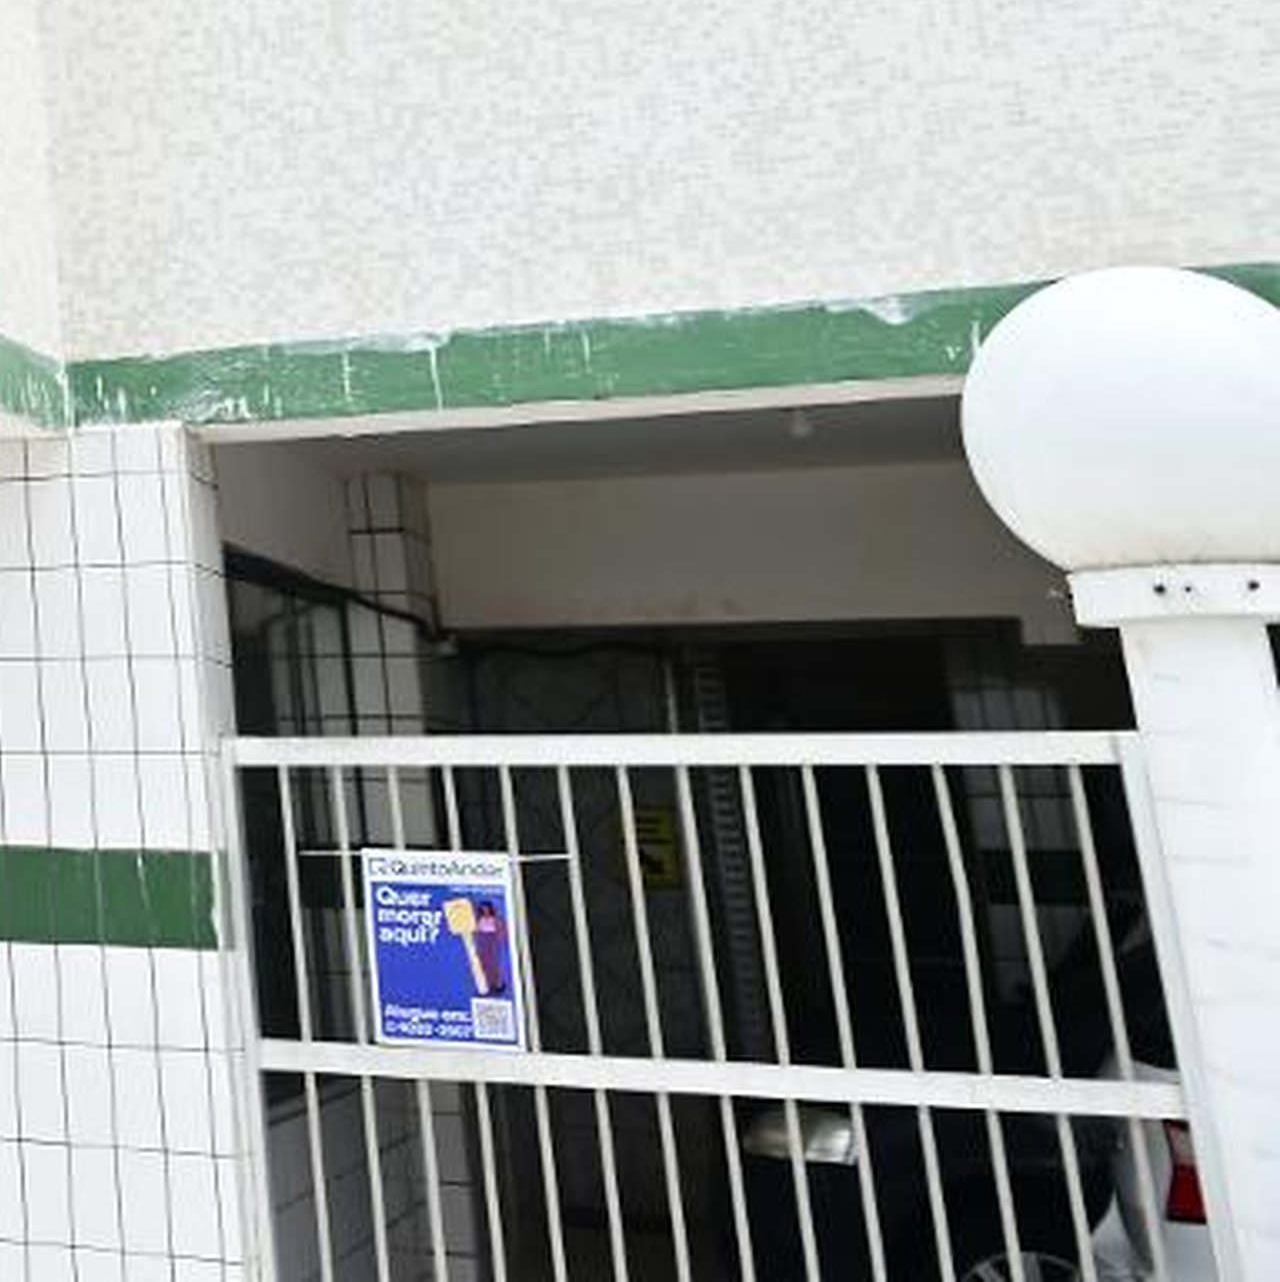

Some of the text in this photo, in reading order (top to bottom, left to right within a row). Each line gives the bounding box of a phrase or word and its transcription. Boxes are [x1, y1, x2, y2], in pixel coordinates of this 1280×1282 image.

[376, 885, 432, 906] Quer
[377, 908, 443, 926] morar
[378, 925, 440, 947] aqui?
